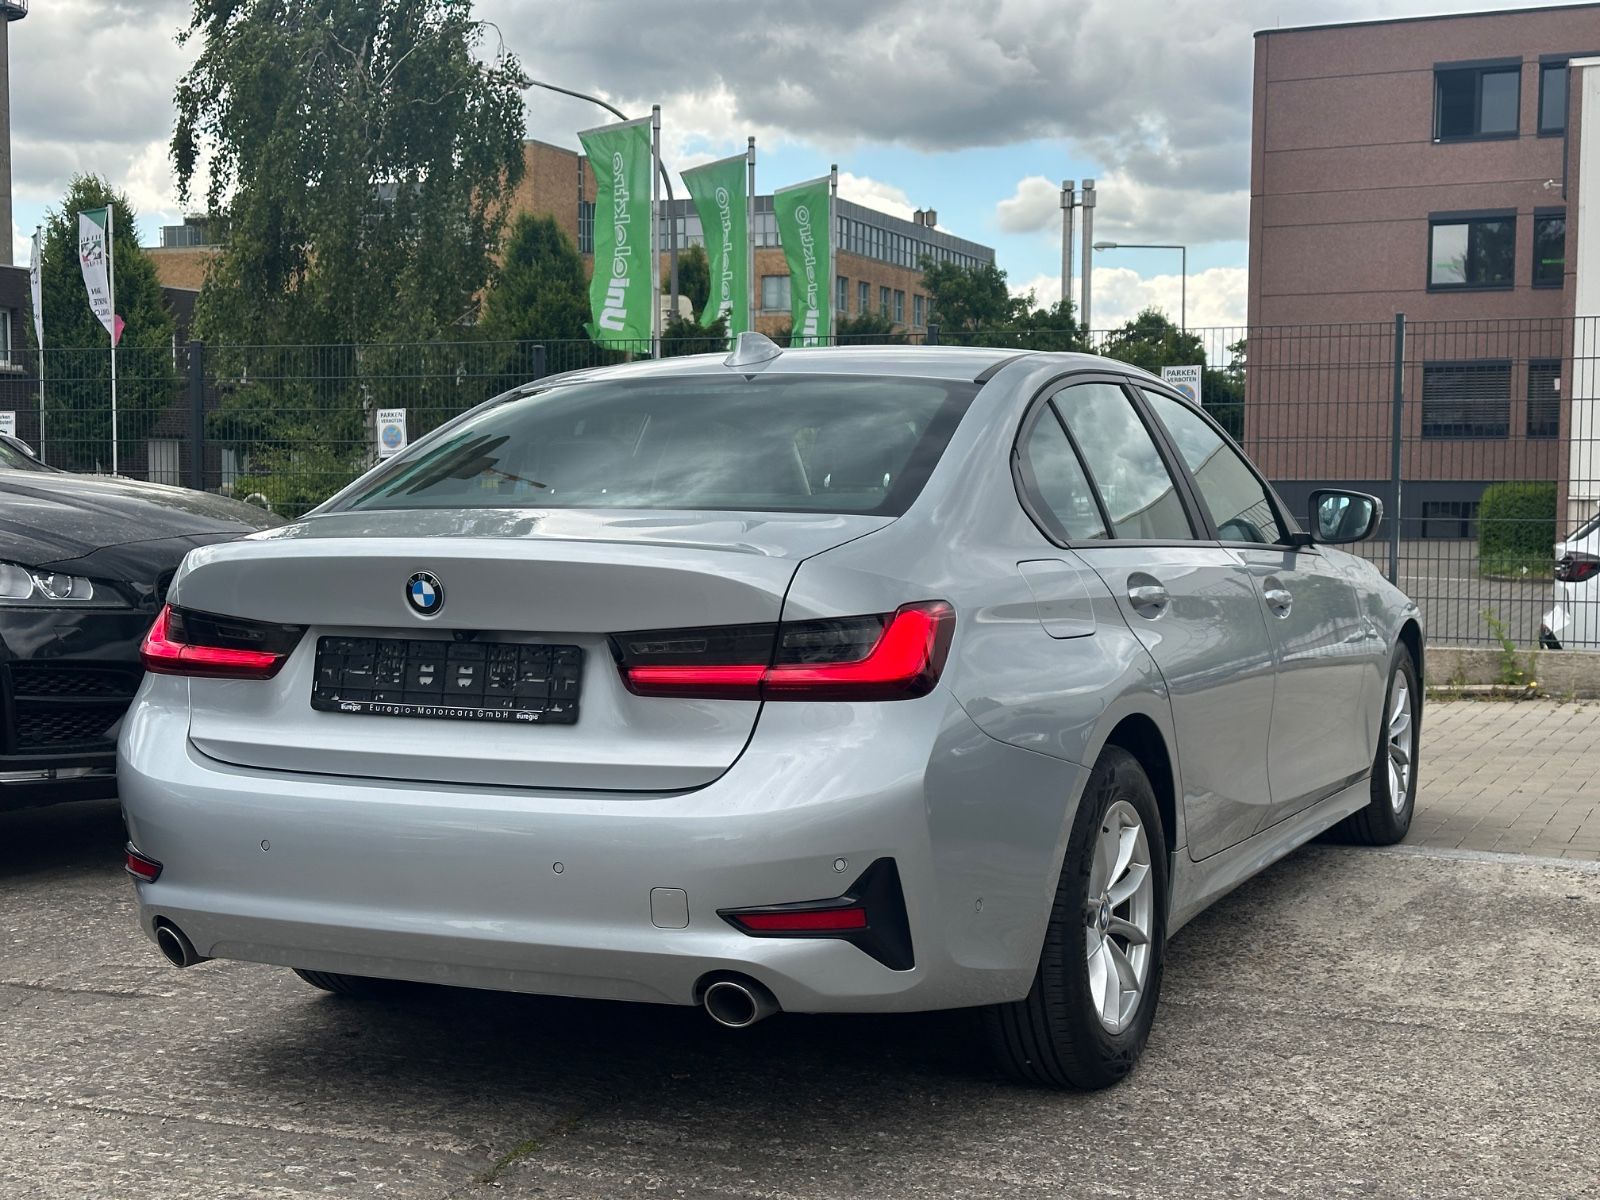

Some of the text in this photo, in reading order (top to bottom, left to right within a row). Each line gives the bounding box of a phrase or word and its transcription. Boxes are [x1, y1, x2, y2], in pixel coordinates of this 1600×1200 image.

[408, 573, 439, 588] BMW
[340, 702, 362, 712] Euregio
[369, 703, 509, 719] Euregio-Motorcars GmbH
[516, 711, 540, 721] Euregio
